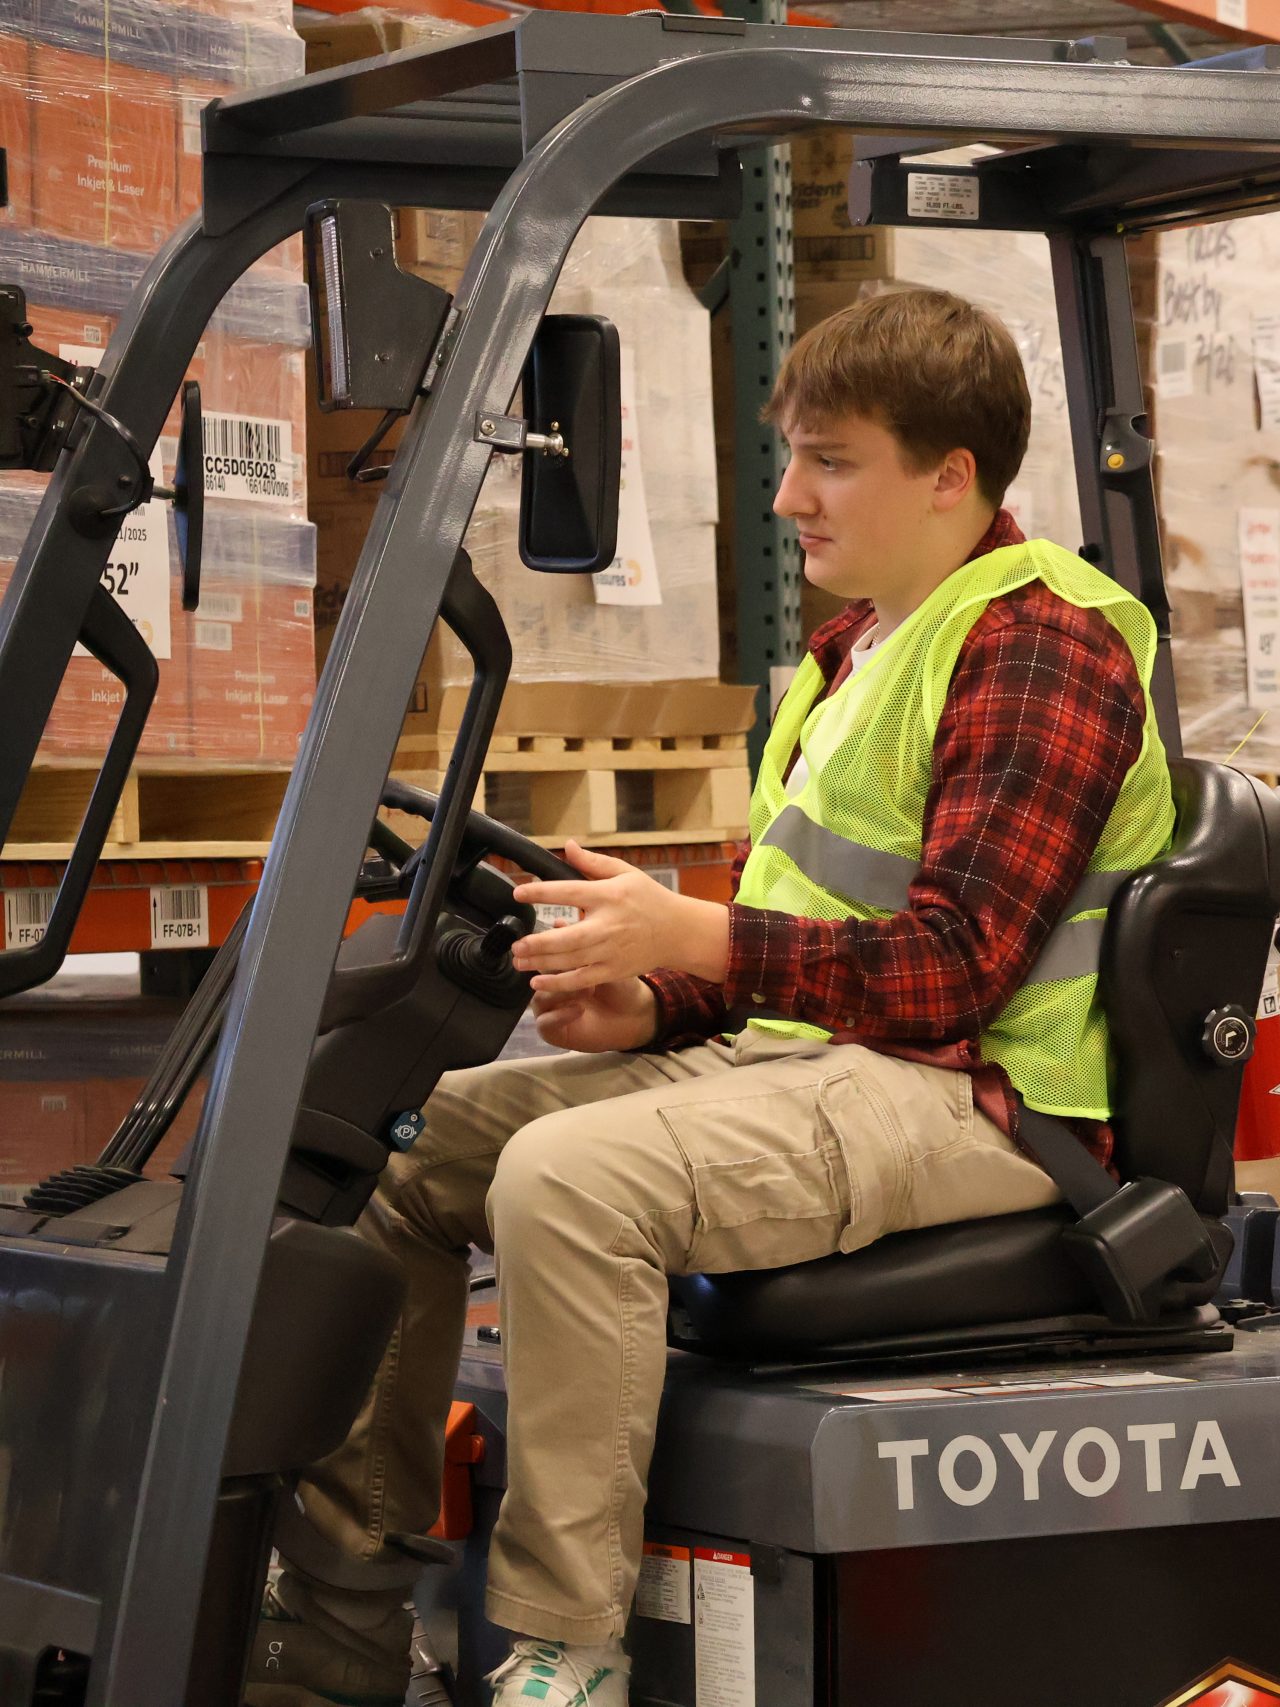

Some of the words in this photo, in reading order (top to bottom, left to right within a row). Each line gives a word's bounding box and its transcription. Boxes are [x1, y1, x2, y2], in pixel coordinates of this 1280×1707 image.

[203, 455, 277, 480] CC5D05028
[115, 527, 147, 543] 1/2025
[18, 928, 45, 943] FF-07
[878, 1420, 1241, 1511] TOYOTA
